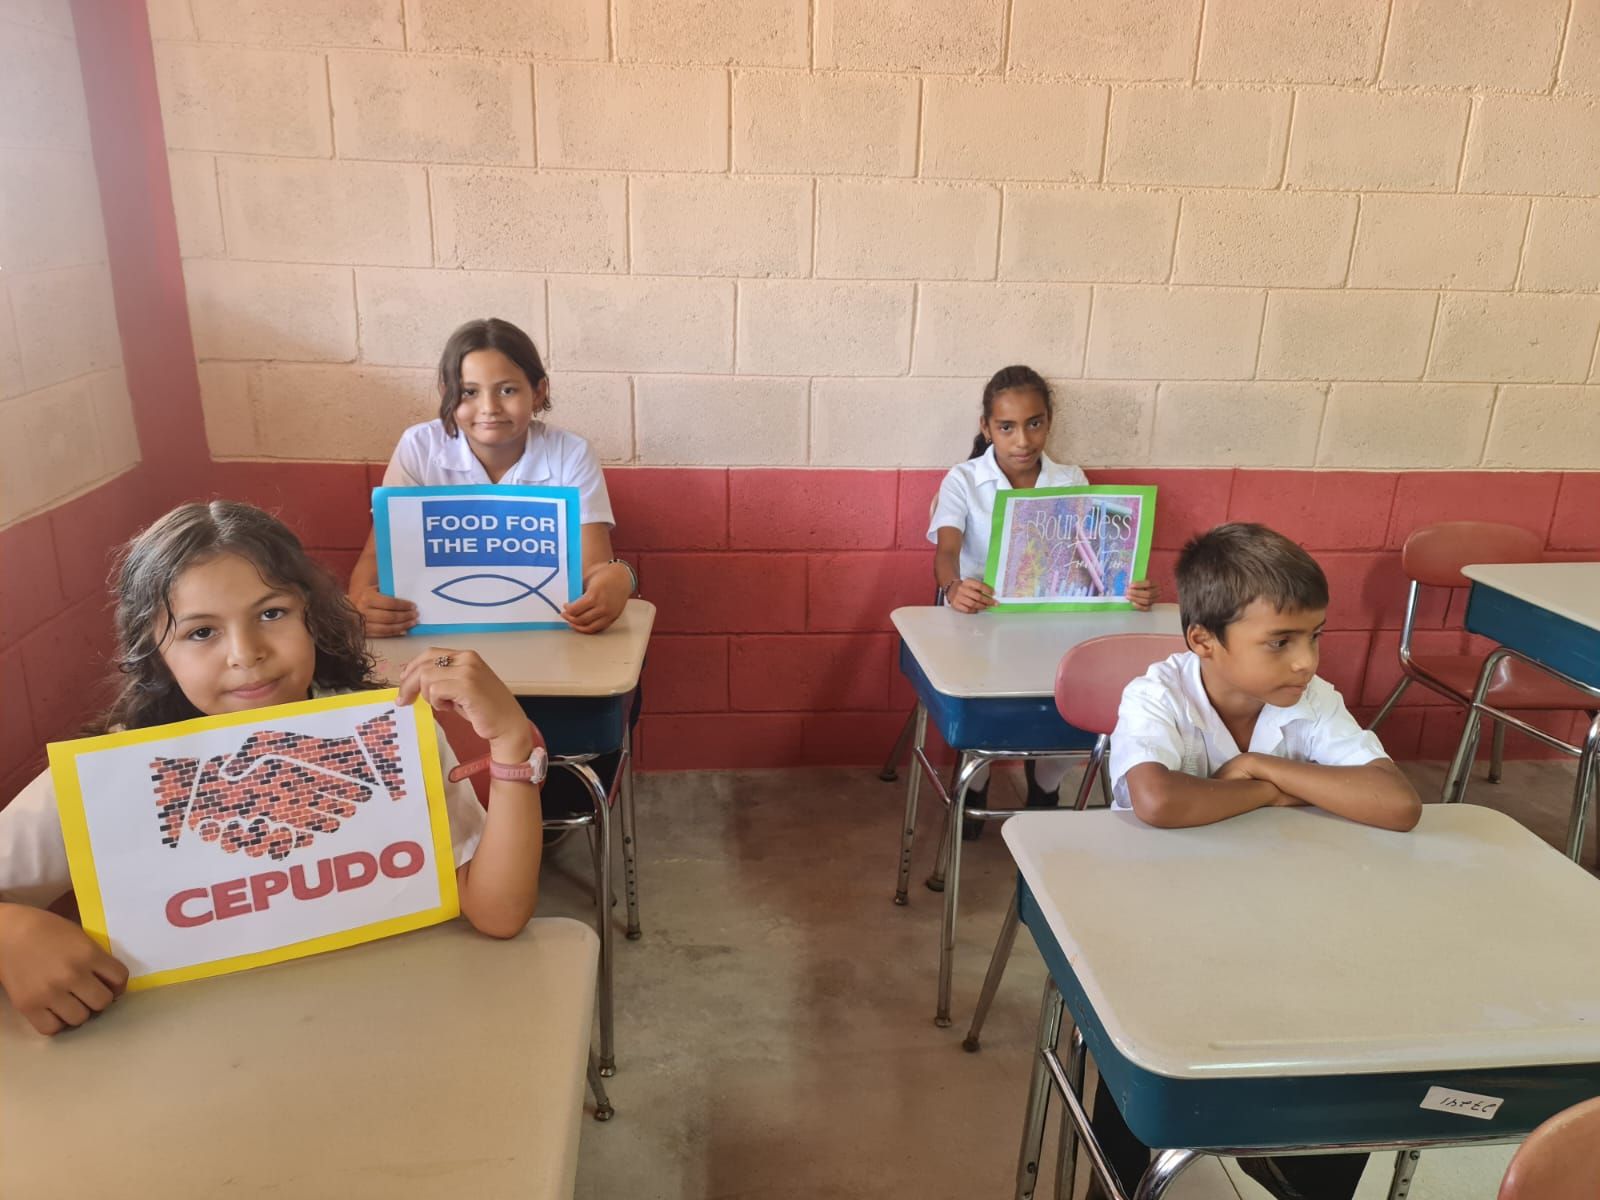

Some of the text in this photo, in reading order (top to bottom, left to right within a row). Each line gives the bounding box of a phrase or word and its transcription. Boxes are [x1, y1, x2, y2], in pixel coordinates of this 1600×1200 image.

[425, 515, 556, 533] FOOD FOR
[1027, 506, 1133, 542] Boundless
[427, 537, 556, 555] THE POOR
[164, 840, 425, 928] CEPUDO
